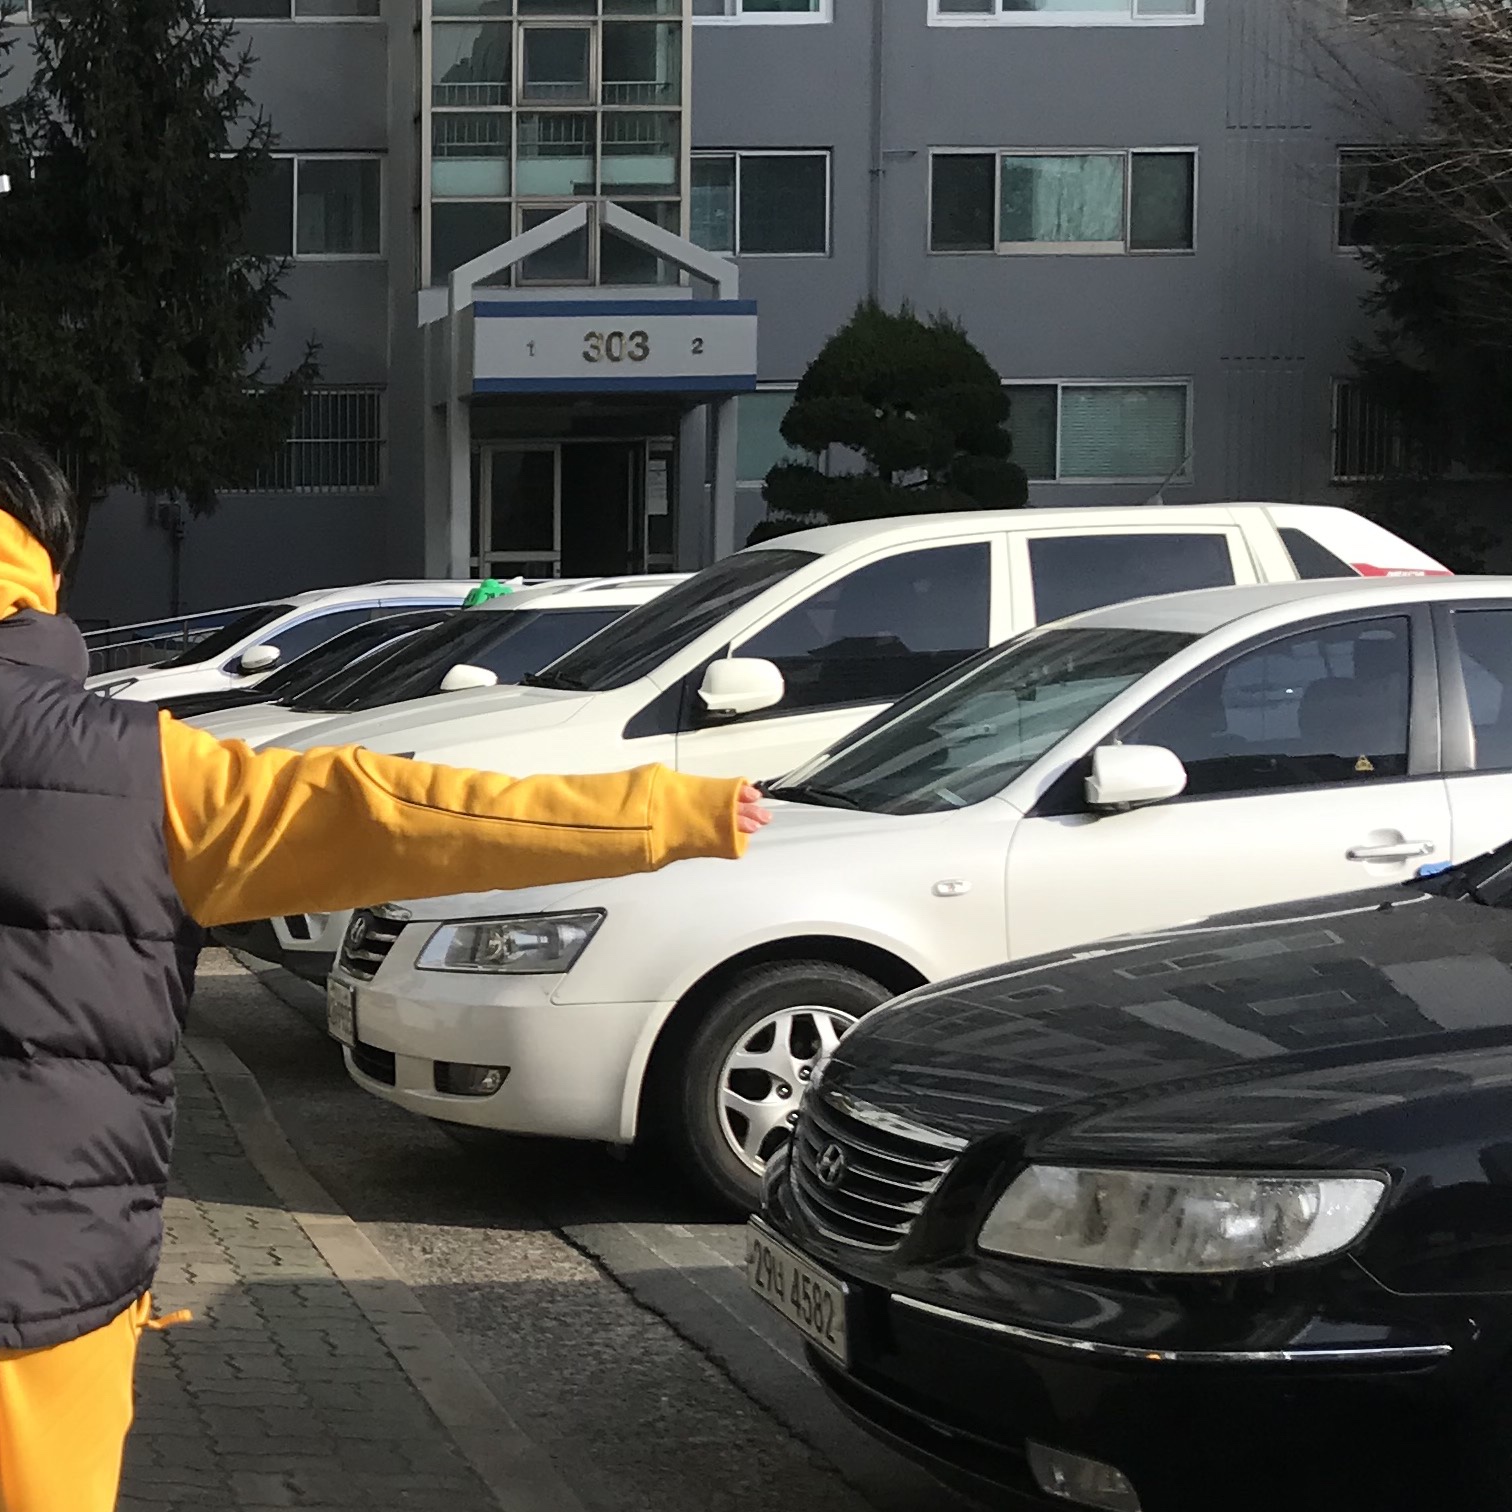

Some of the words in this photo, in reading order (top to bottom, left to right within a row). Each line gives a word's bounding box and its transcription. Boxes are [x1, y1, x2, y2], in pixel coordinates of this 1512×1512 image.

[526, 340, 536, 357] 1
[582, 330, 650, 363] 303
[691, 337, 704, 355] 2
[790, 1266, 836, 1345] 4582
